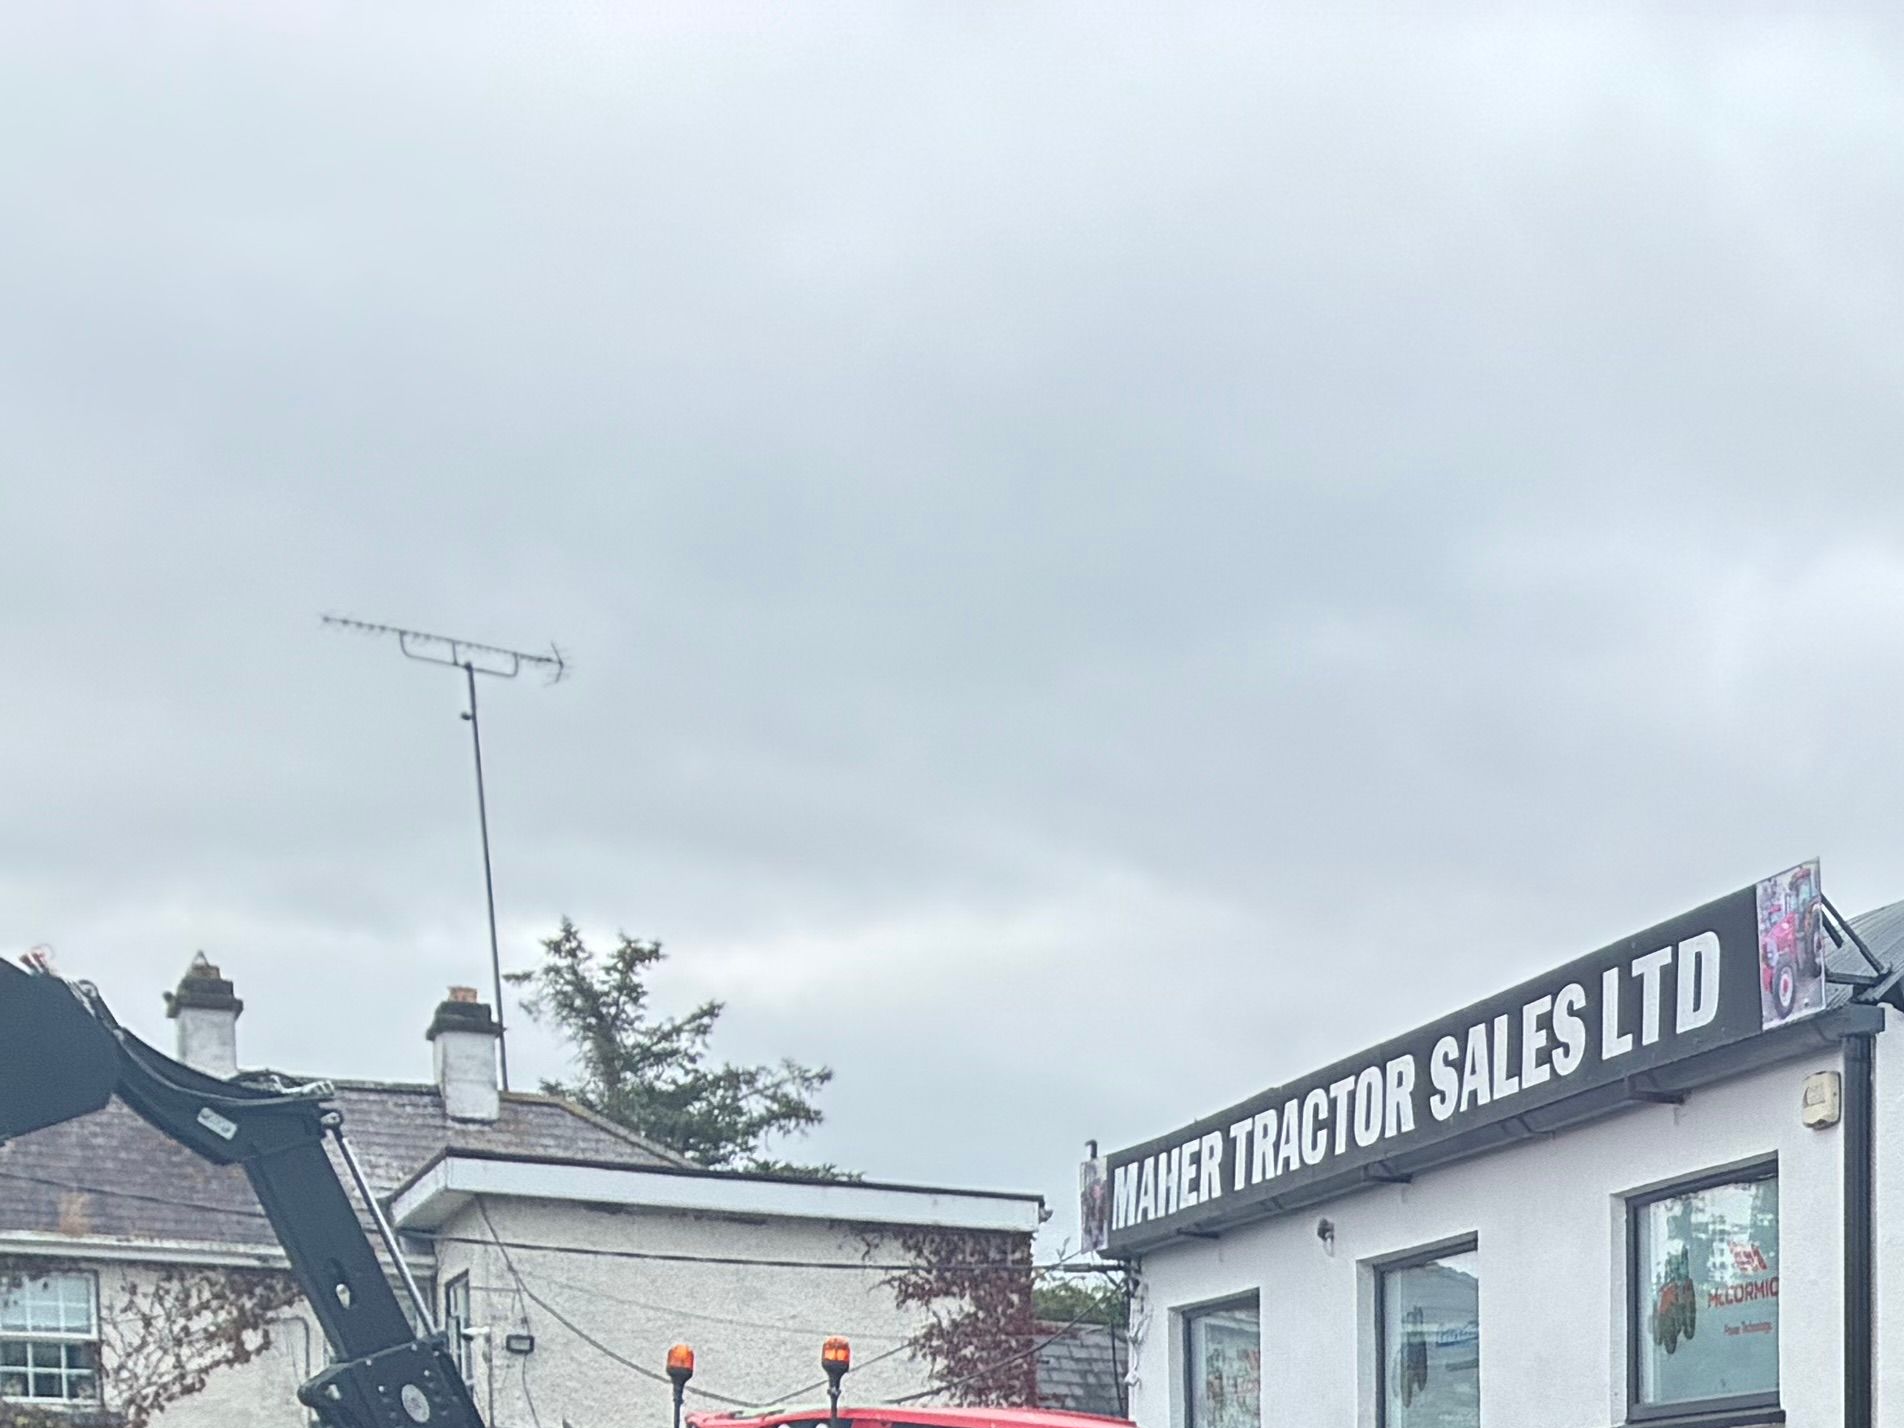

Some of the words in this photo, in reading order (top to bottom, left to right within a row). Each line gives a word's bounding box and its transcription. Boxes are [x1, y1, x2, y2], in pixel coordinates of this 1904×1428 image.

[1110, 1131, 1224, 1232] MAHER
[1229, 1055, 1418, 1188] TRACTOR
[1429, 983, 1588, 1121] SALES
[1601, 930, 1722, 1060] LTD
[1707, 1276, 1780, 1308] McCORMIC
